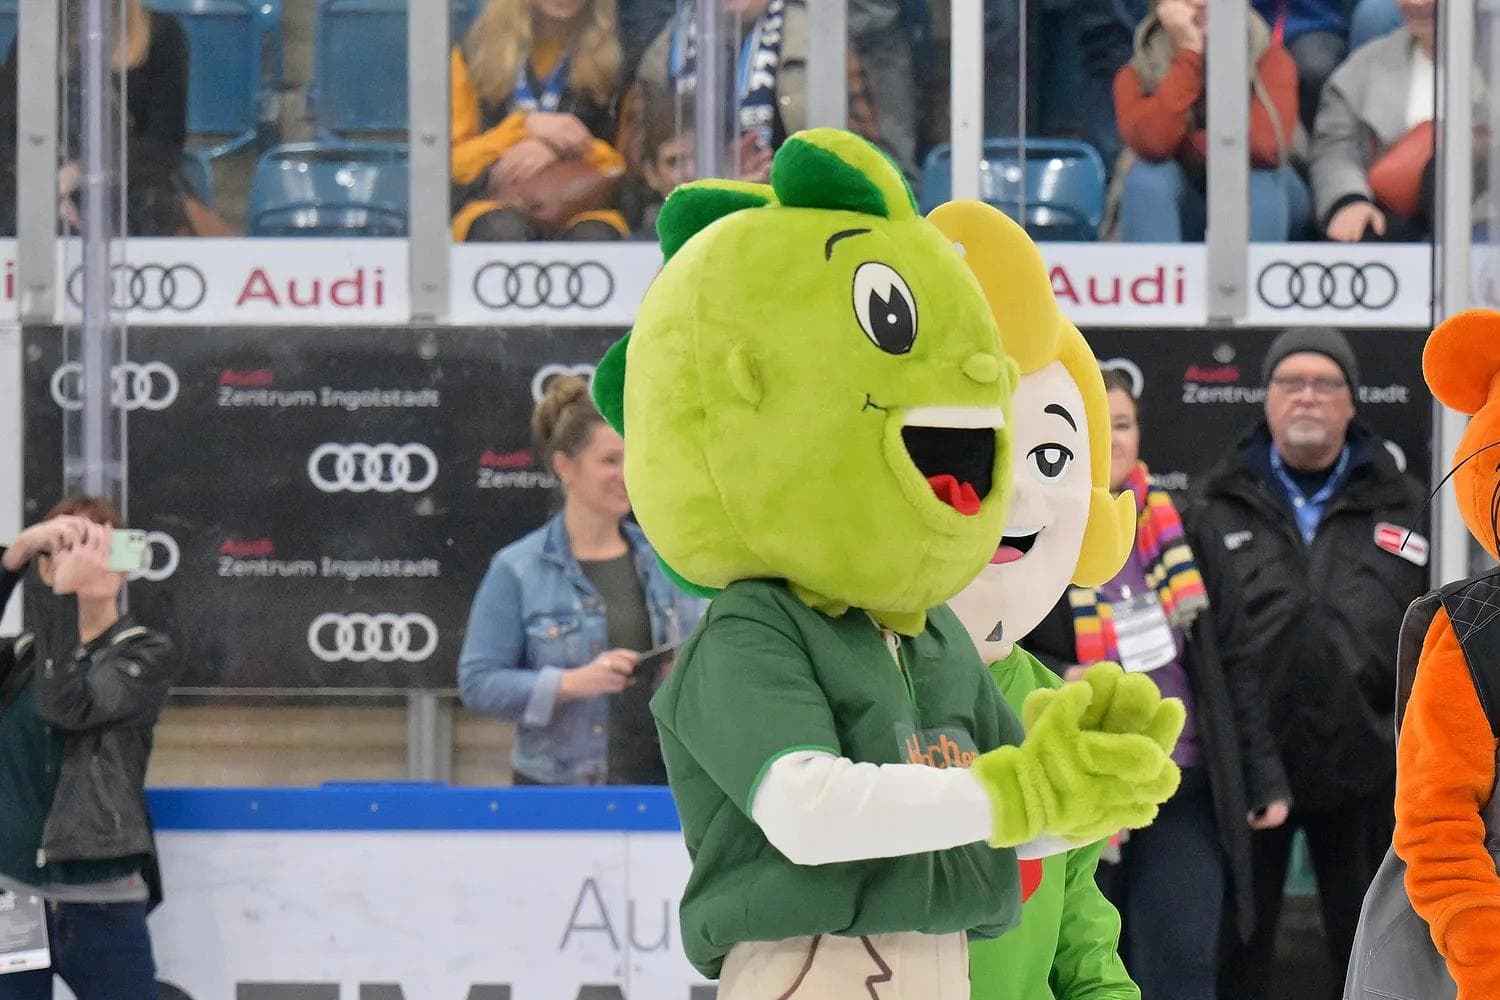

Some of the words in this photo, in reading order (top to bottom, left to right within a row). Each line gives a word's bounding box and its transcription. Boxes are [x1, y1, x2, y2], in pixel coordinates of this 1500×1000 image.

[236, 266, 386, 308] Audi
[1051, 264, 1185, 305] Audi
[217, 386, 317, 407] Zentrum
[319, 386, 441, 411] Ingolstadt
[477, 467, 561, 489] Zentru
[218, 556, 317, 577] Zentrum
[320, 556, 441, 581] Ingolstadt
[559, 876, 671, 951] Au
